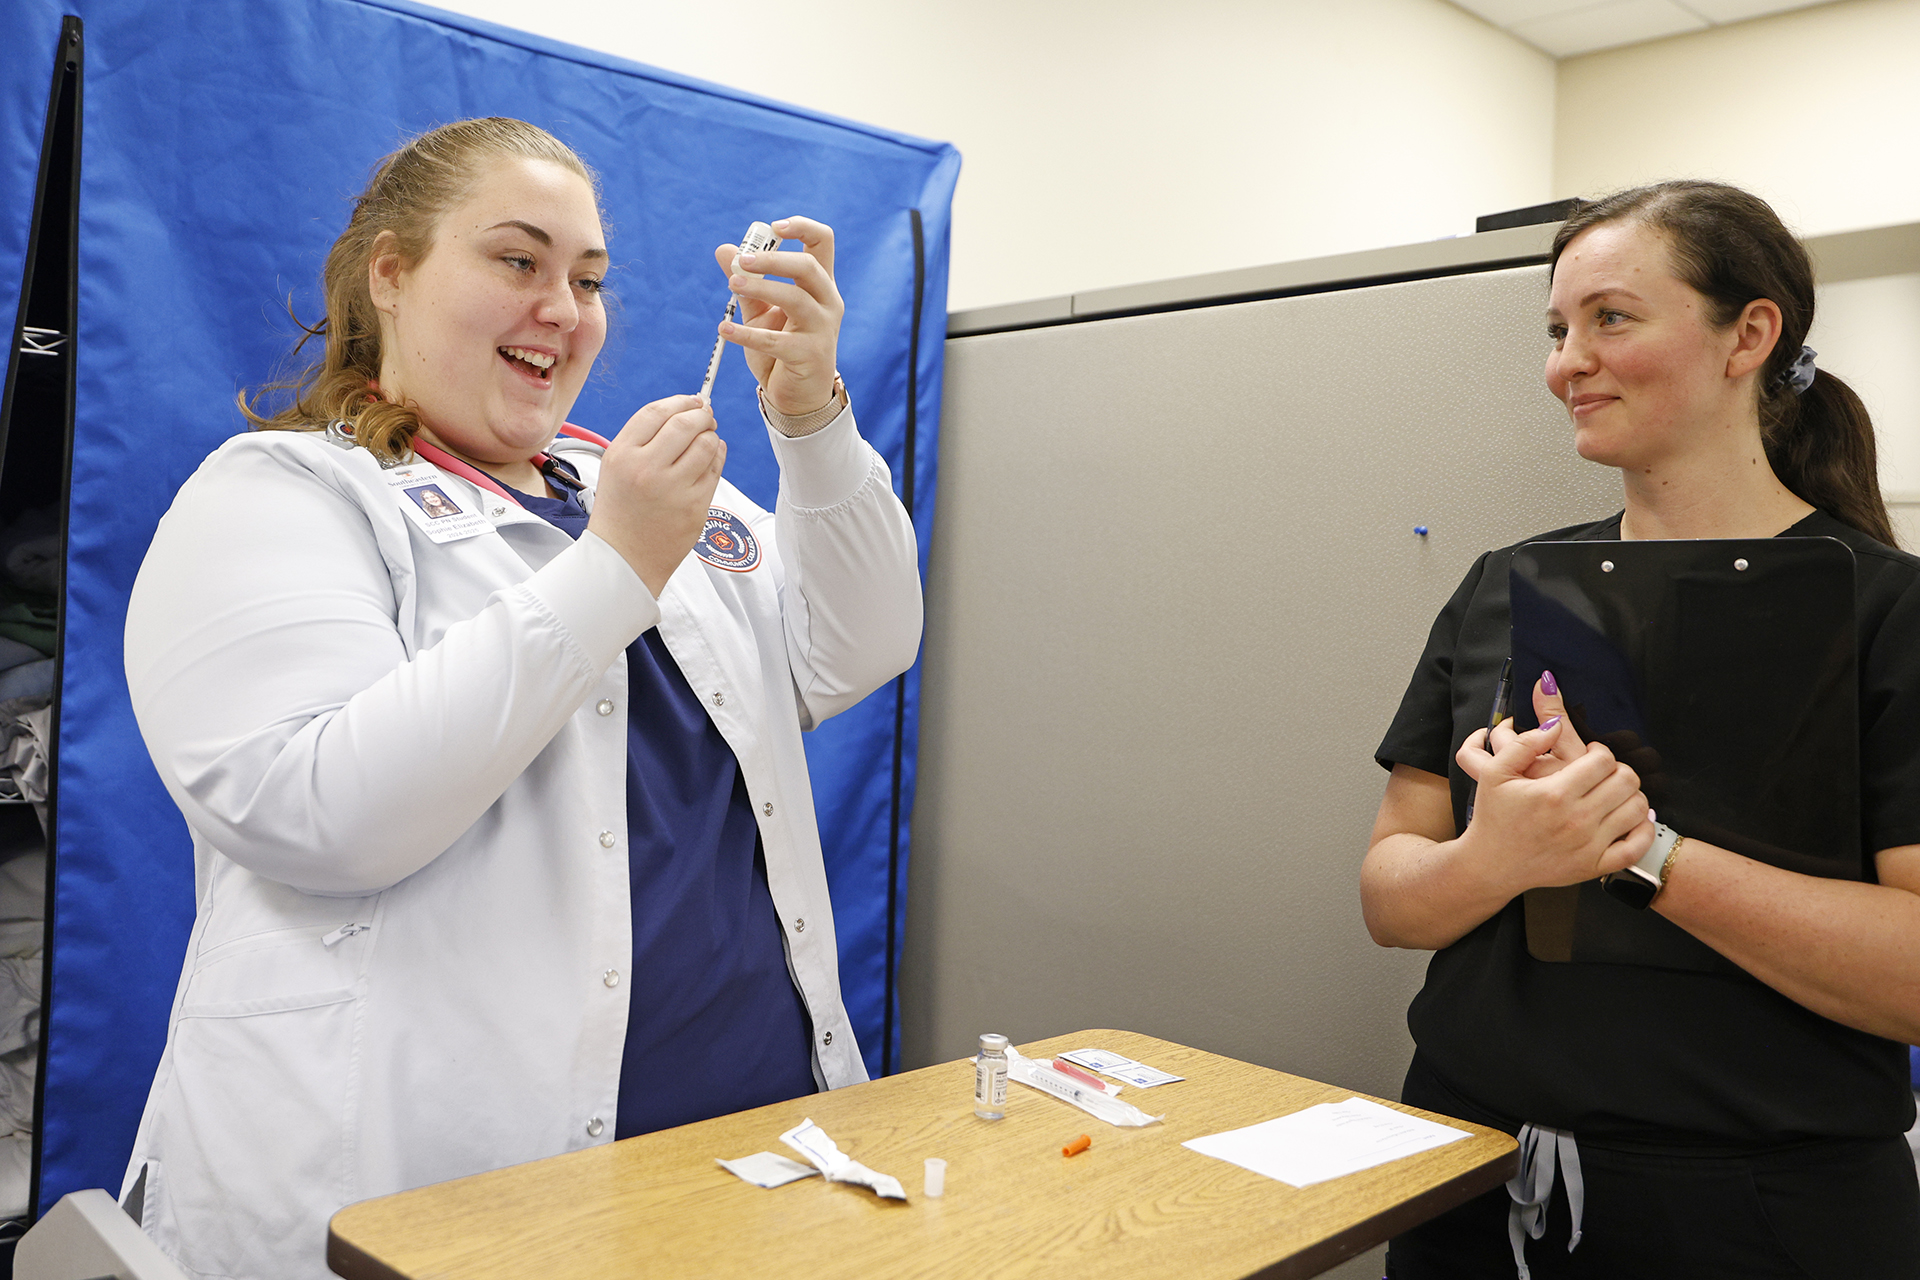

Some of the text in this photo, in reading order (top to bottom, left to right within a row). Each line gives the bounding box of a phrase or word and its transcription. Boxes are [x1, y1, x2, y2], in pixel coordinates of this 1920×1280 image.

[387, 474, 438, 487] Southeastern
[452, 513, 478, 522] Student
[425, 519, 487, 535] Sophie Elizabeth
